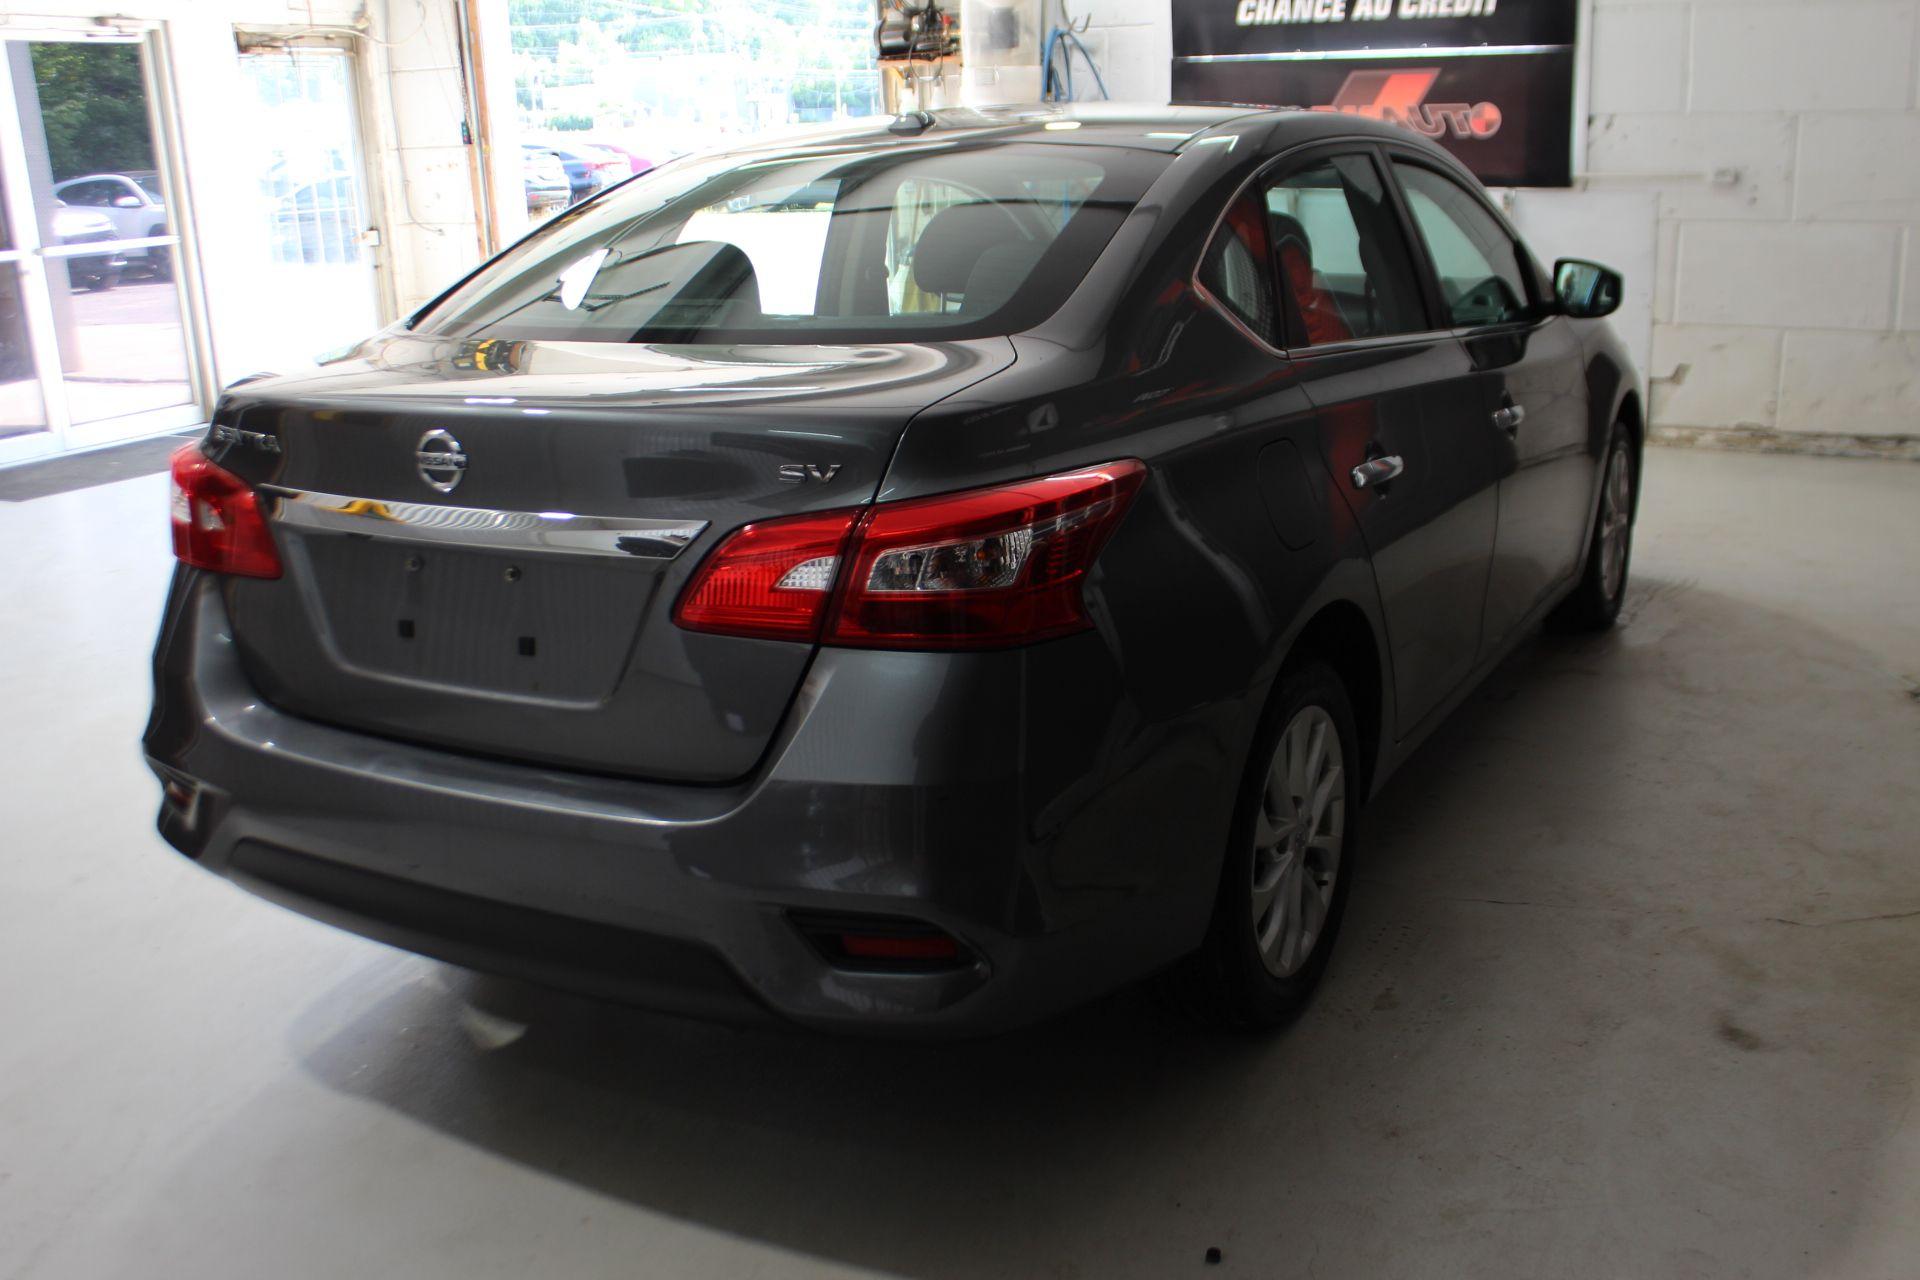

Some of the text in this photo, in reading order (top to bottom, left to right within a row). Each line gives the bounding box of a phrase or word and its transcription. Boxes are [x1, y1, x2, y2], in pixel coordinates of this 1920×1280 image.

[1236, 0, 1346, 25] CHANCE
[1351, 0, 1392, 21] AU
[779, 464, 841, 482] SV
